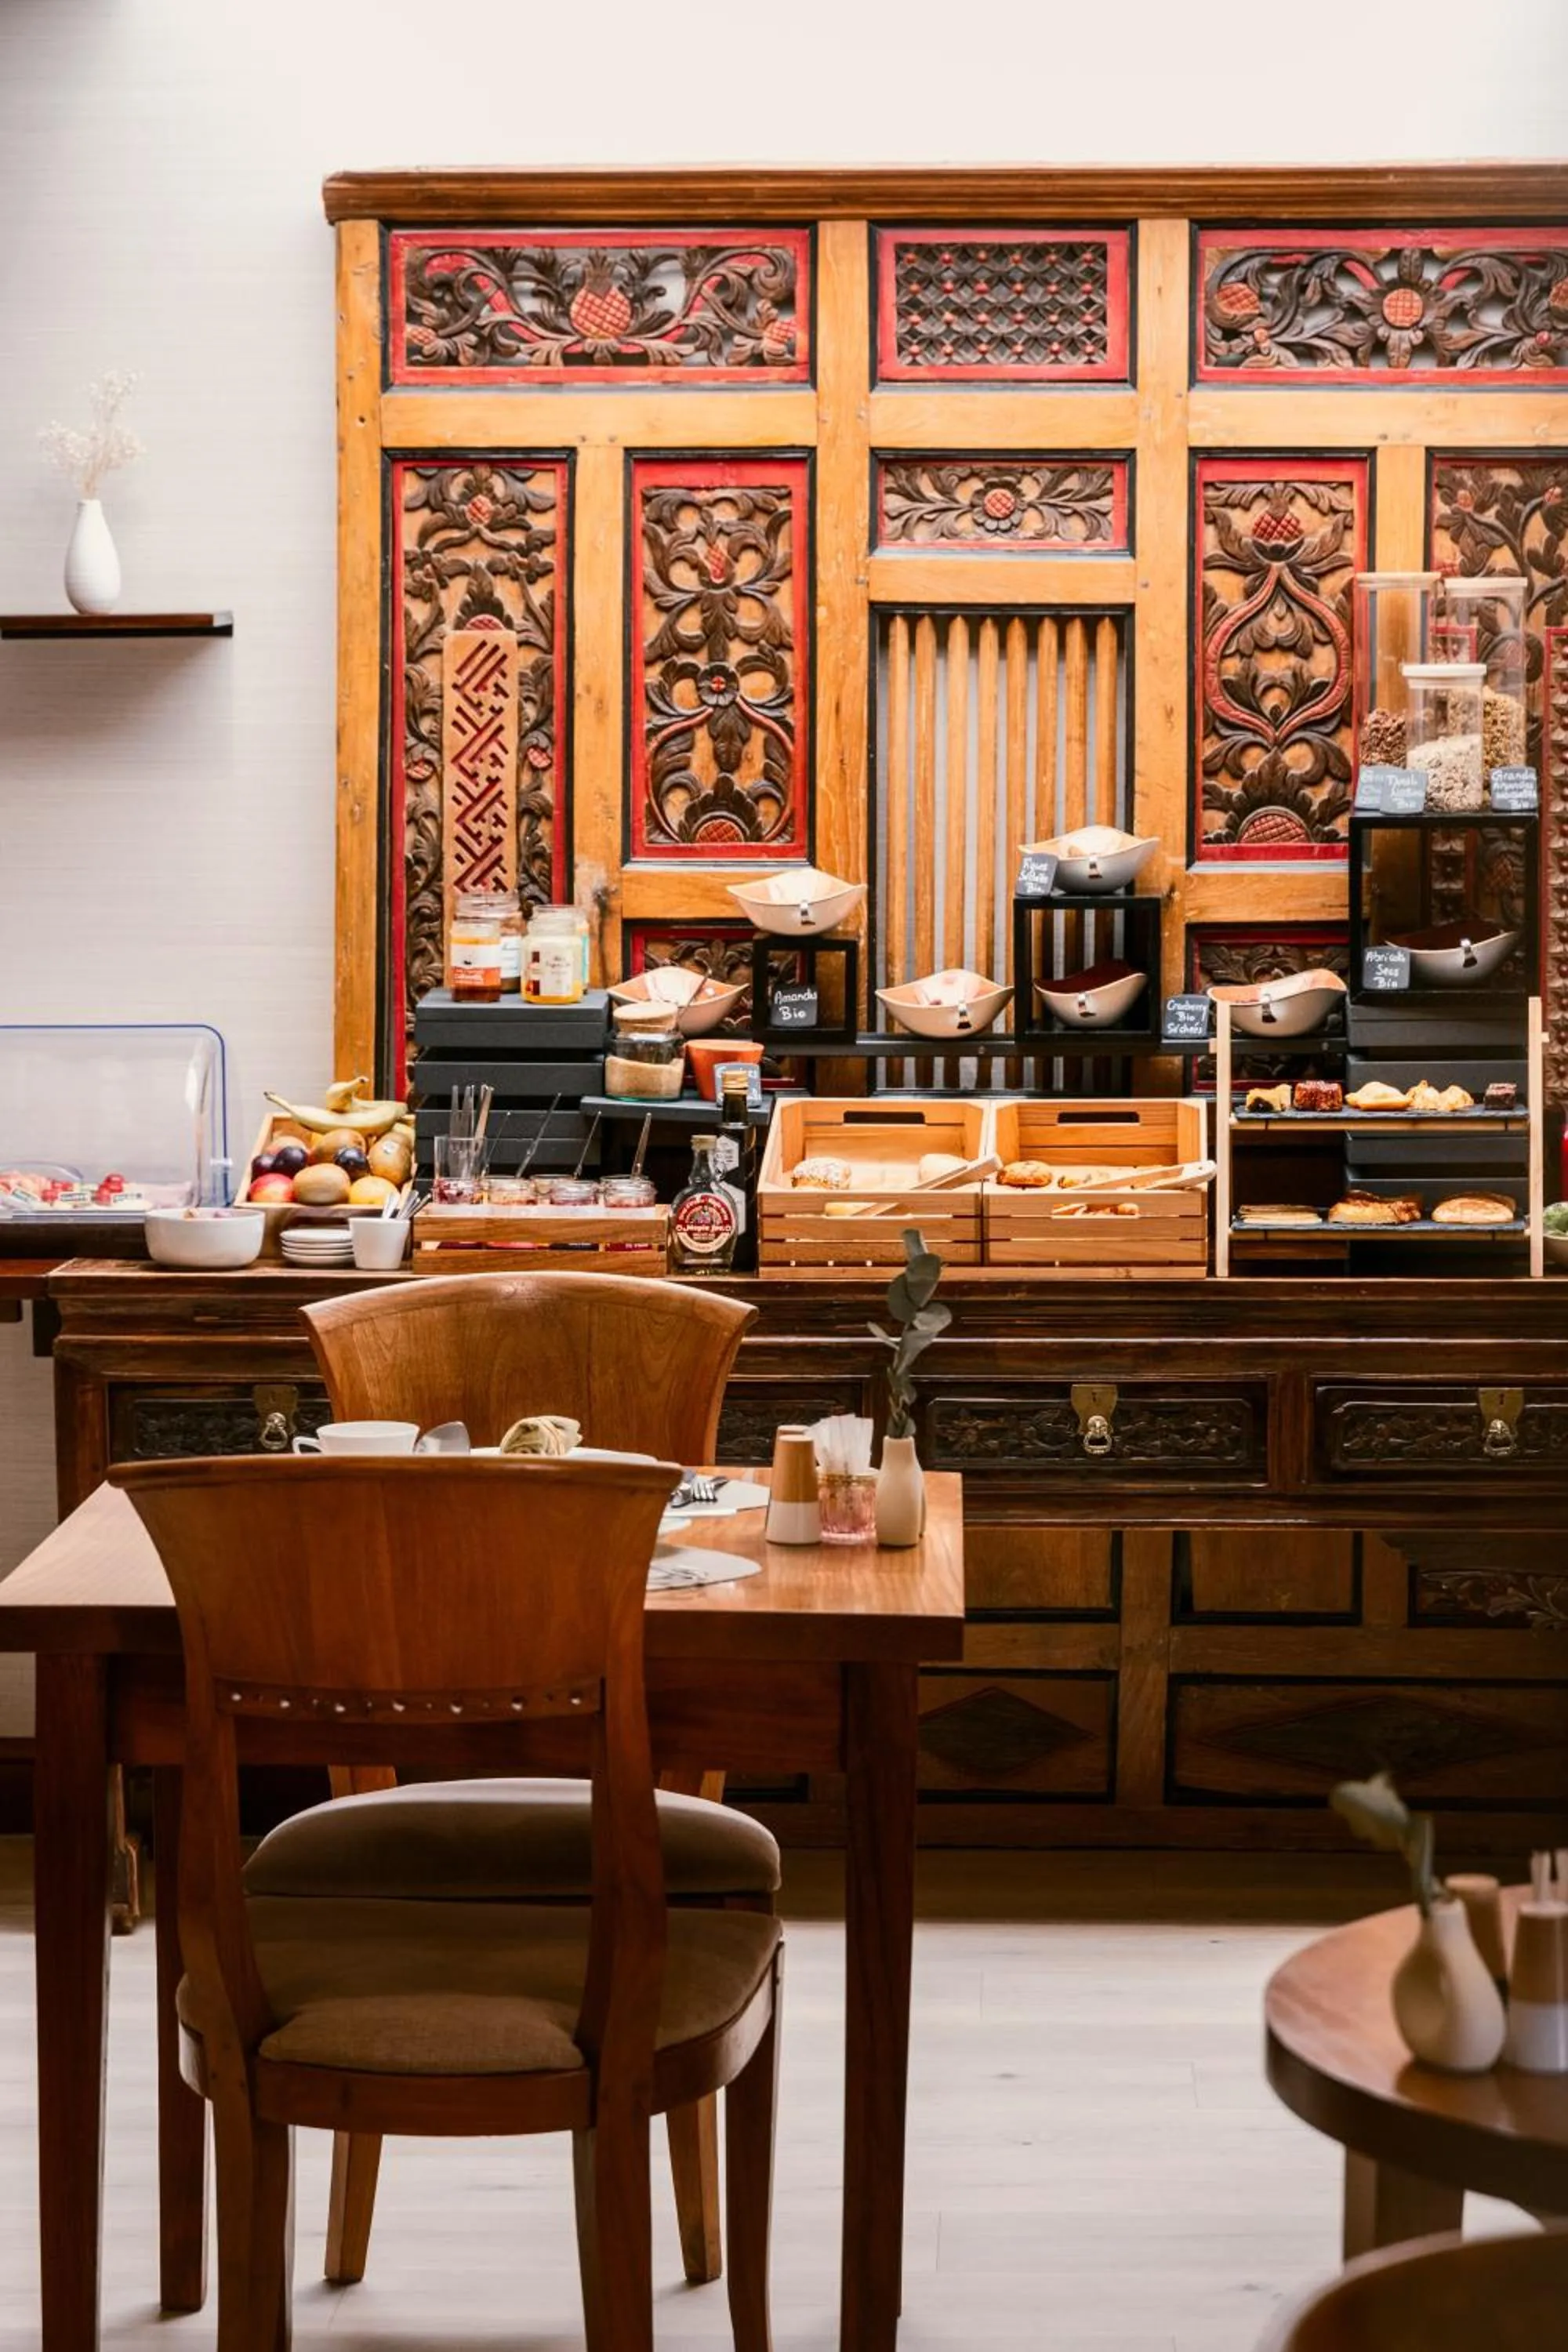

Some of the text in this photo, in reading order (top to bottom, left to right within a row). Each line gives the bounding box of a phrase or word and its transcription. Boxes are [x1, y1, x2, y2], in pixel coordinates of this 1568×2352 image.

[1372, 976, 1398, 989] Bio
[779, 1006, 807, 1021] Bio
[1175, 1011, 1196, 1022] Bio
